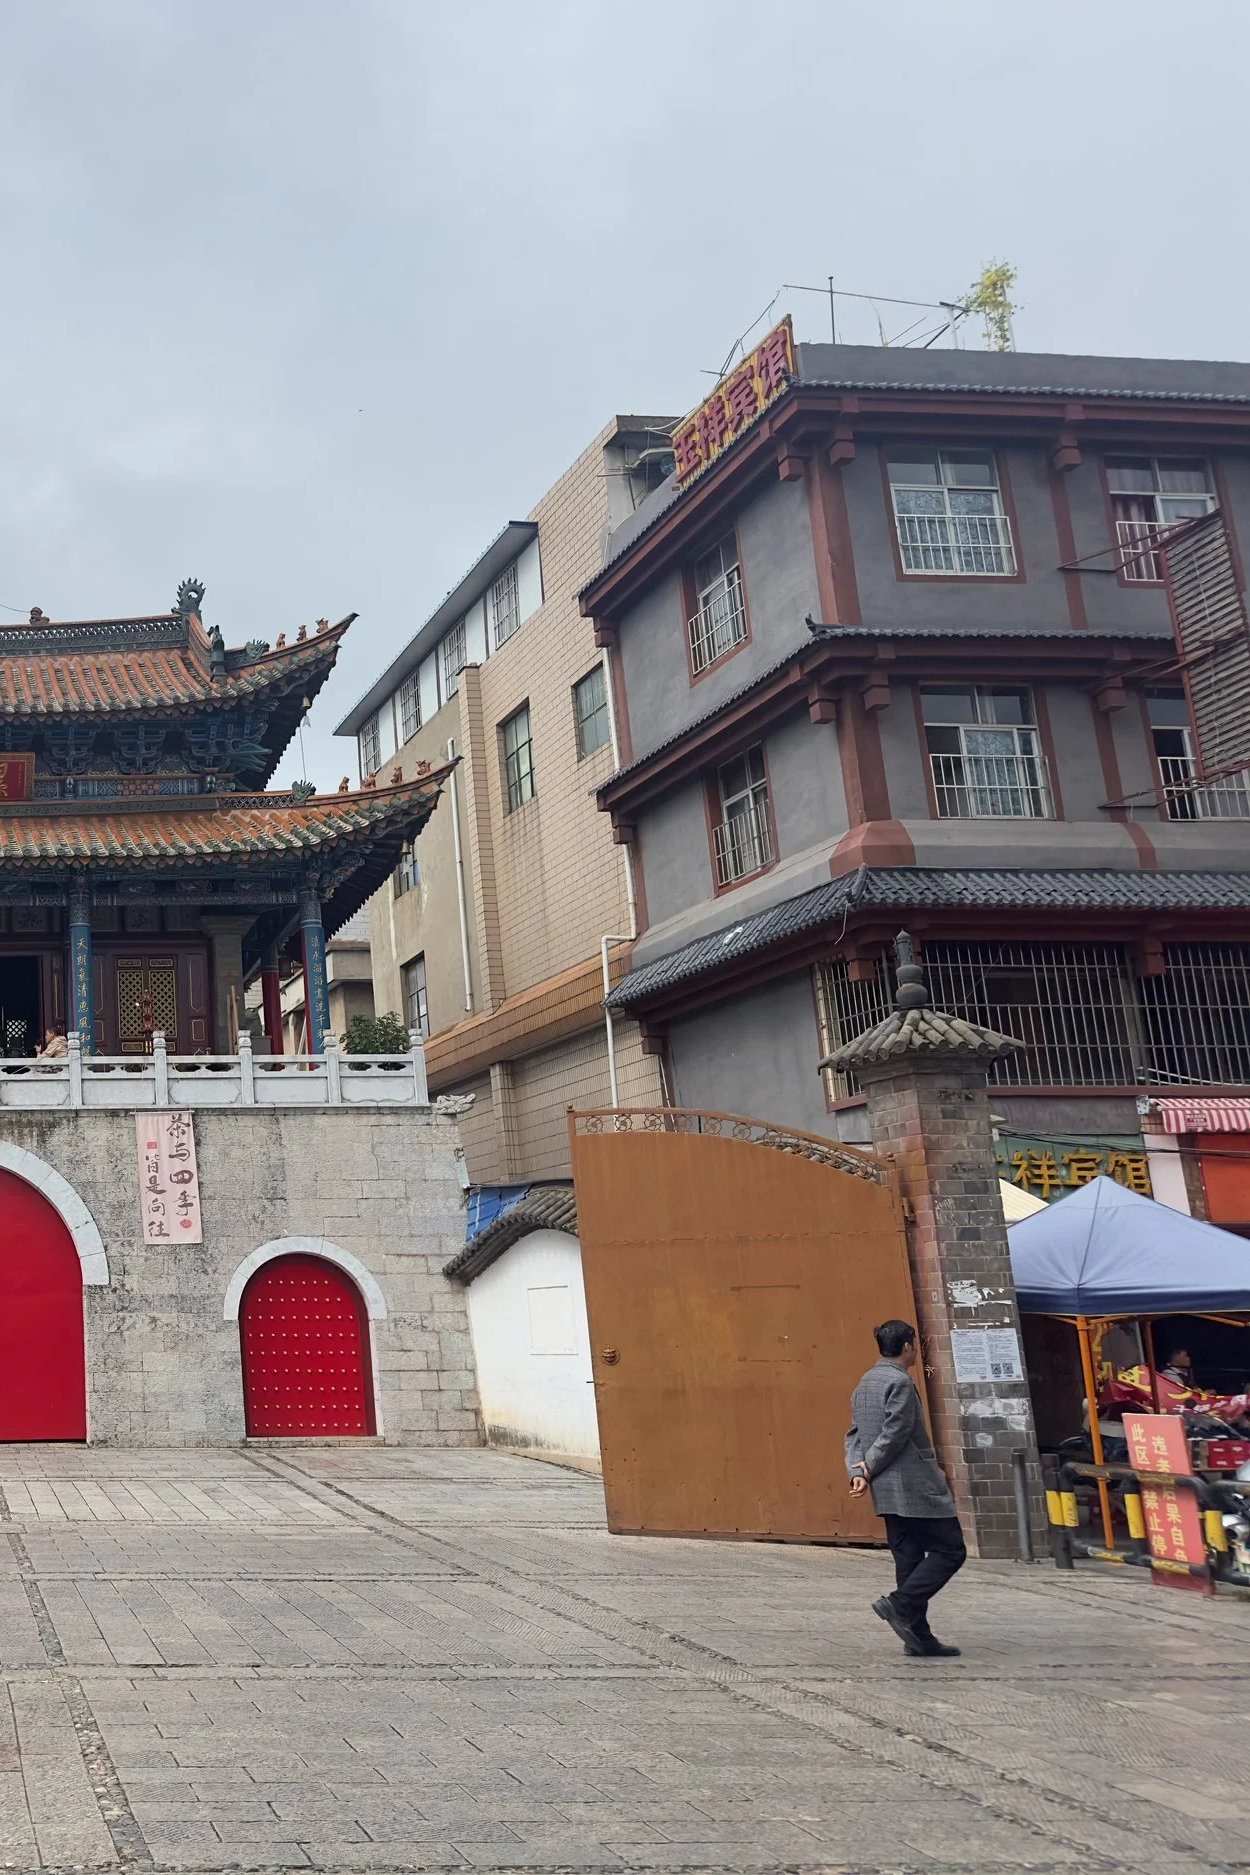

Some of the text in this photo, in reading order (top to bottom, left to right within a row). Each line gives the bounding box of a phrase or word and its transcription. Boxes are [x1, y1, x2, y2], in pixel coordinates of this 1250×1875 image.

[672, 328, 791, 483] 玉祥宾馆
[166, 1113, 197, 1216] 茶与四季
[1131, 1423, 1167, 1555] 此区禁止停
